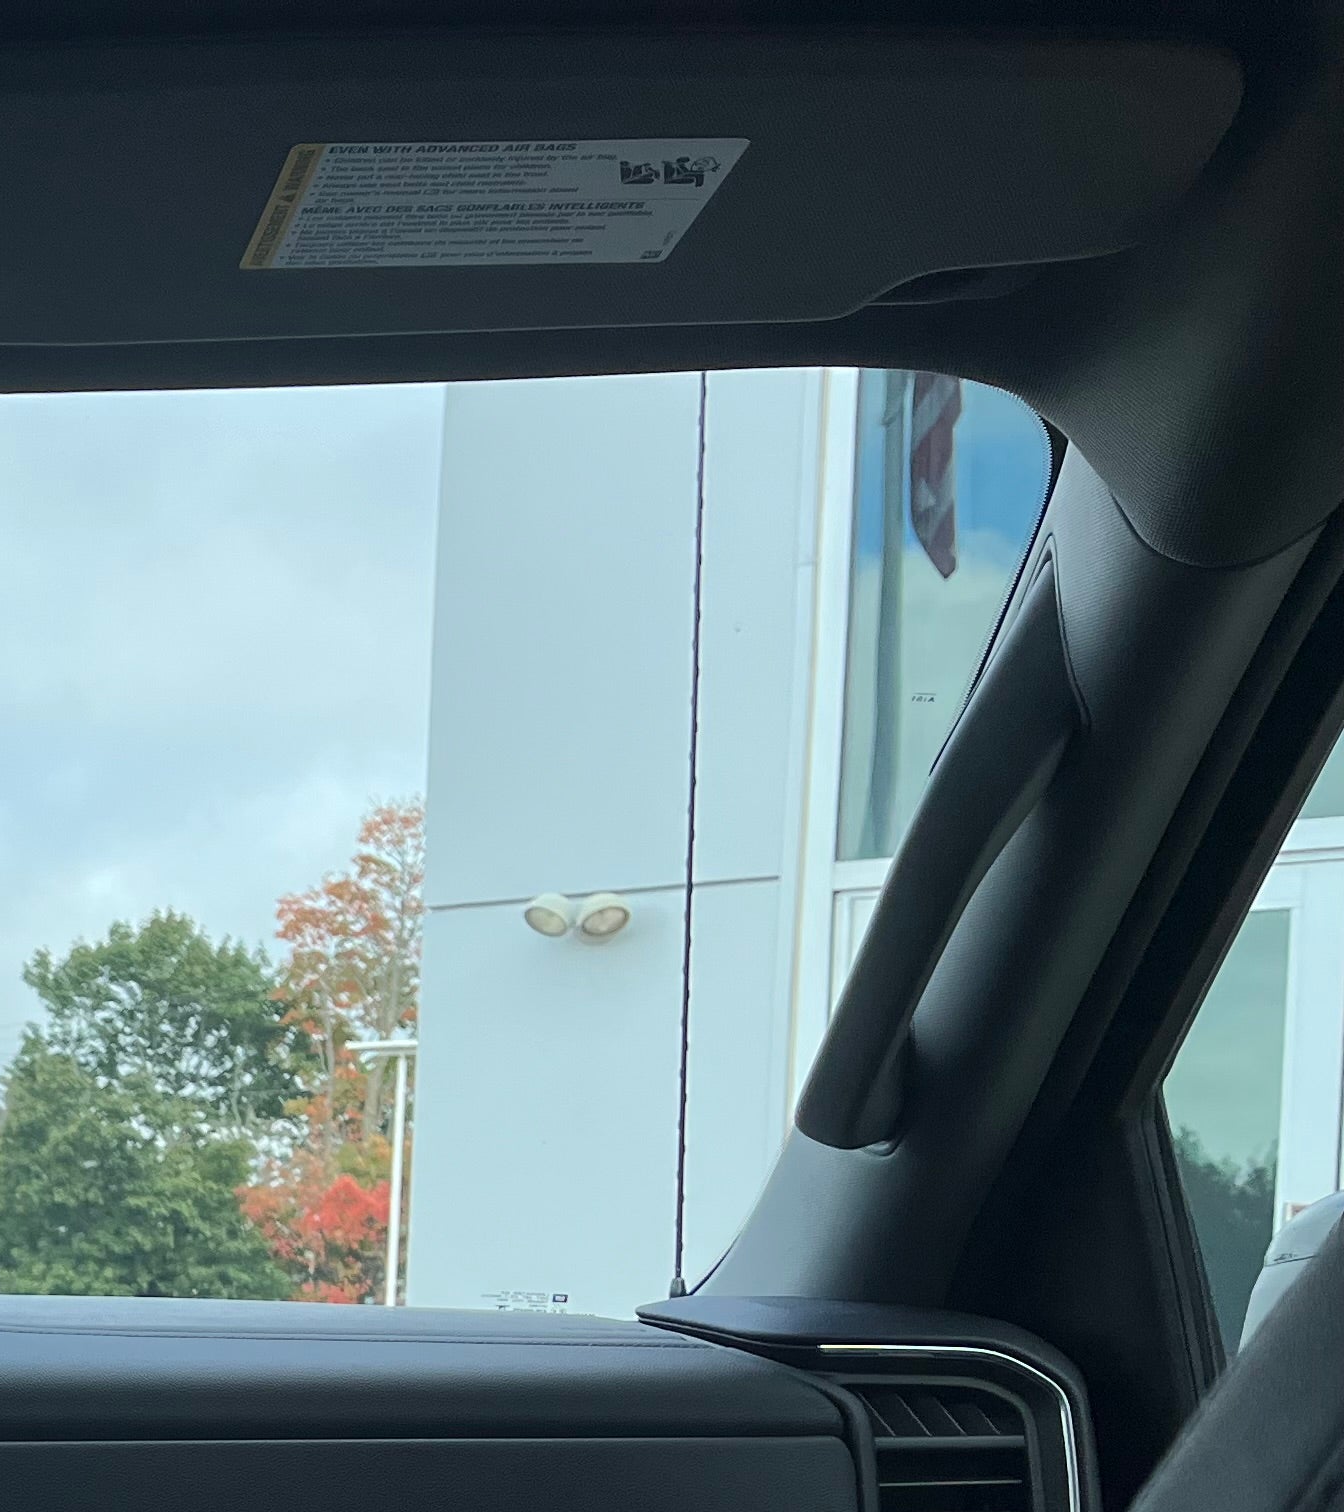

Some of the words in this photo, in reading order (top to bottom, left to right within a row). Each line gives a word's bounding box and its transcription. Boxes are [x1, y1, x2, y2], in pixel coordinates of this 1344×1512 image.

[328, 145, 369, 154] EVEN
[373, 144, 412, 153] WITH
[416, 143, 500, 153] ADVANCED
[503, 143, 532, 152] AIR
[534, 143, 577, 152] BAGS
[346, 204, 382, 214] AVEC
